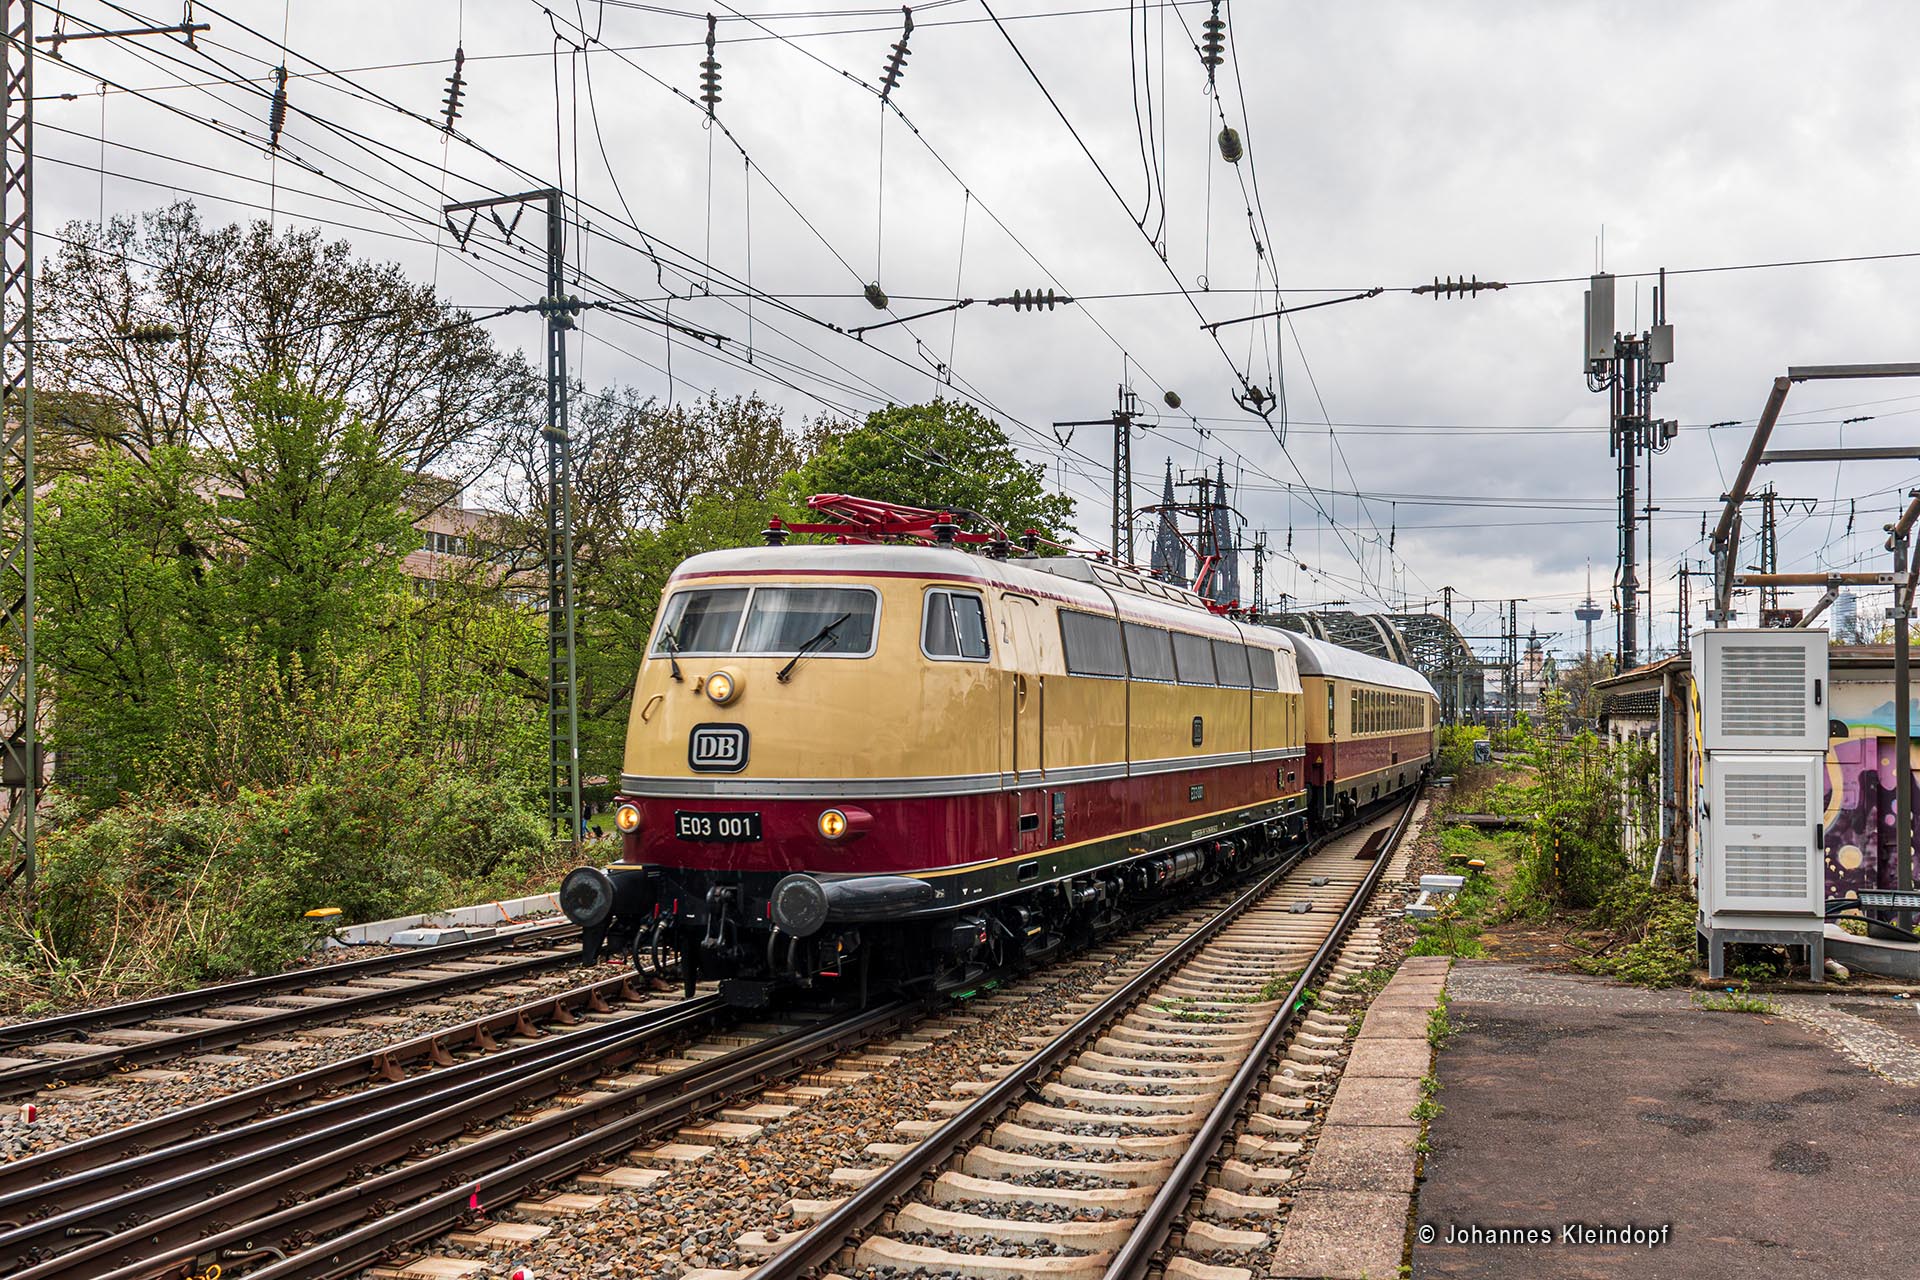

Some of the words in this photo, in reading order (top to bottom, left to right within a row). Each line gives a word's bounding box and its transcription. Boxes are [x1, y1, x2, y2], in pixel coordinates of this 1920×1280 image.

[698, 736, 735, 758] DB
[680, 816, 712, 835] E03
[719, 818, 751, 836] 001
